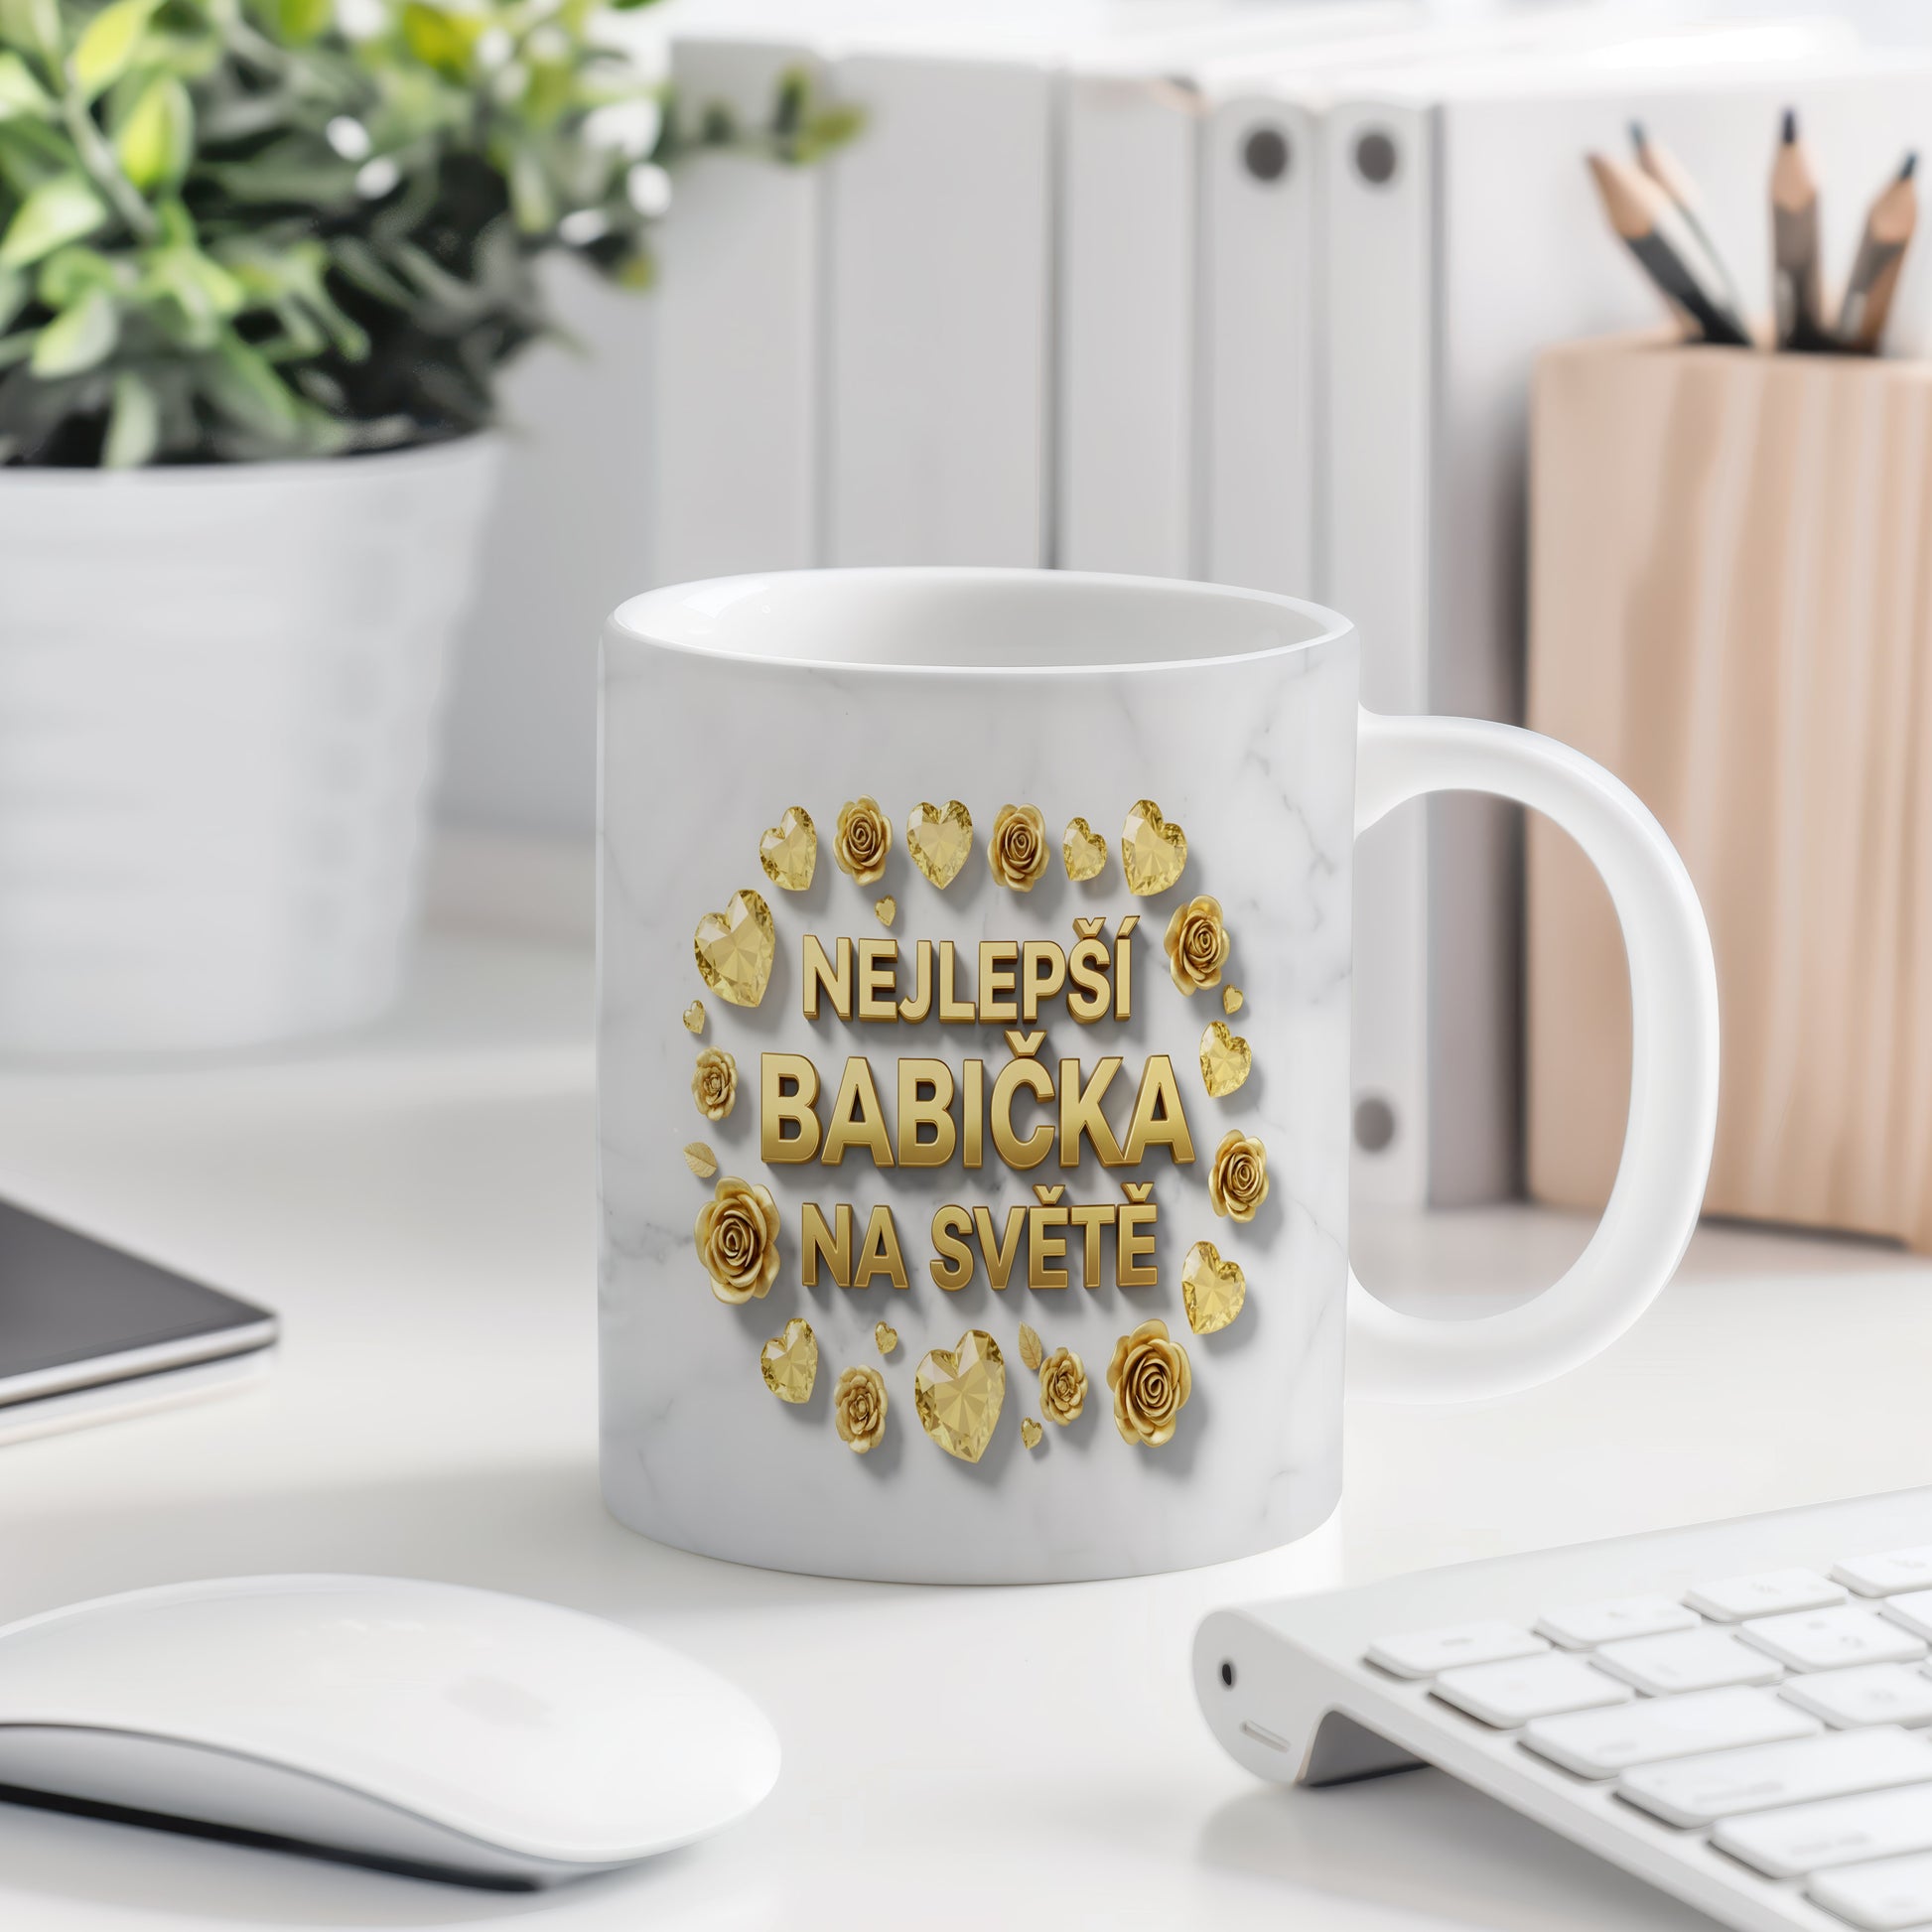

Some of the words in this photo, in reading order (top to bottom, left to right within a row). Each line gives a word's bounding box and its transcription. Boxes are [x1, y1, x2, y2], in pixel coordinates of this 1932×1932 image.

[802, 915, 1140, 1024] NEJLEPŠÍ
[760, 1031, 1196, 1169] BABIČKA
[801, 1202, 909, 1289] NA
[929, 1182, 1158, 1291] SVĚTĚ
